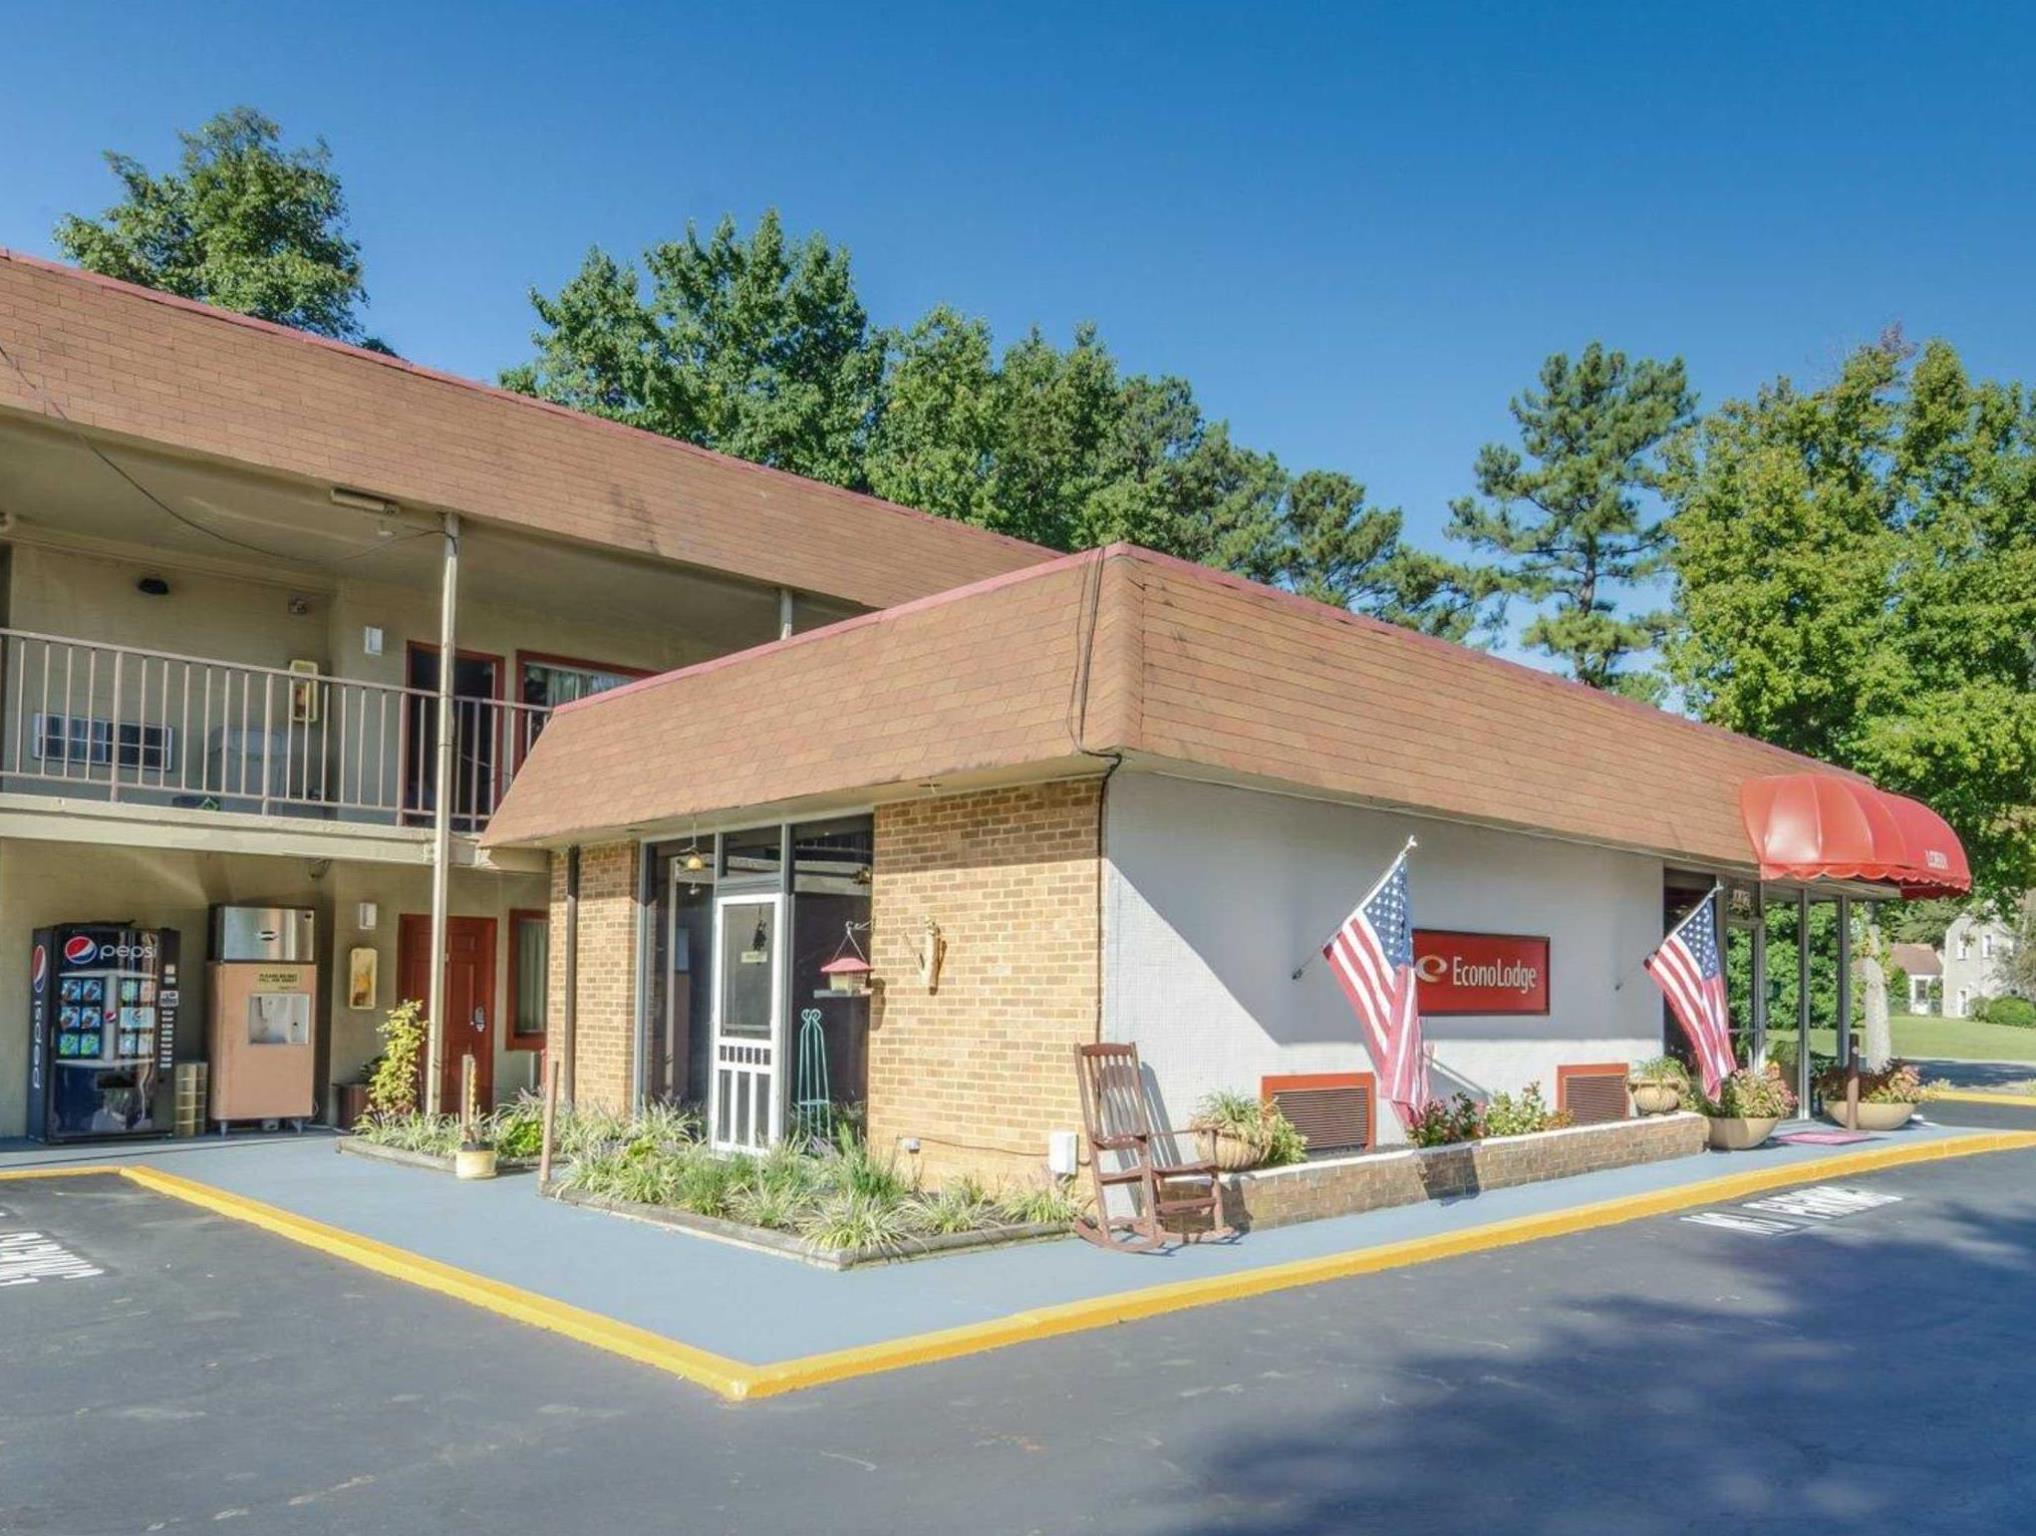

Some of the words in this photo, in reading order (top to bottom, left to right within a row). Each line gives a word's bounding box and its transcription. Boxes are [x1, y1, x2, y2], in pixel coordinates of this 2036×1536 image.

[100, 944, 157, 960] pepsi
[1453, 955, 1537, 994] EconoLodge
[33, 1001, 42, 1089] pepsi
